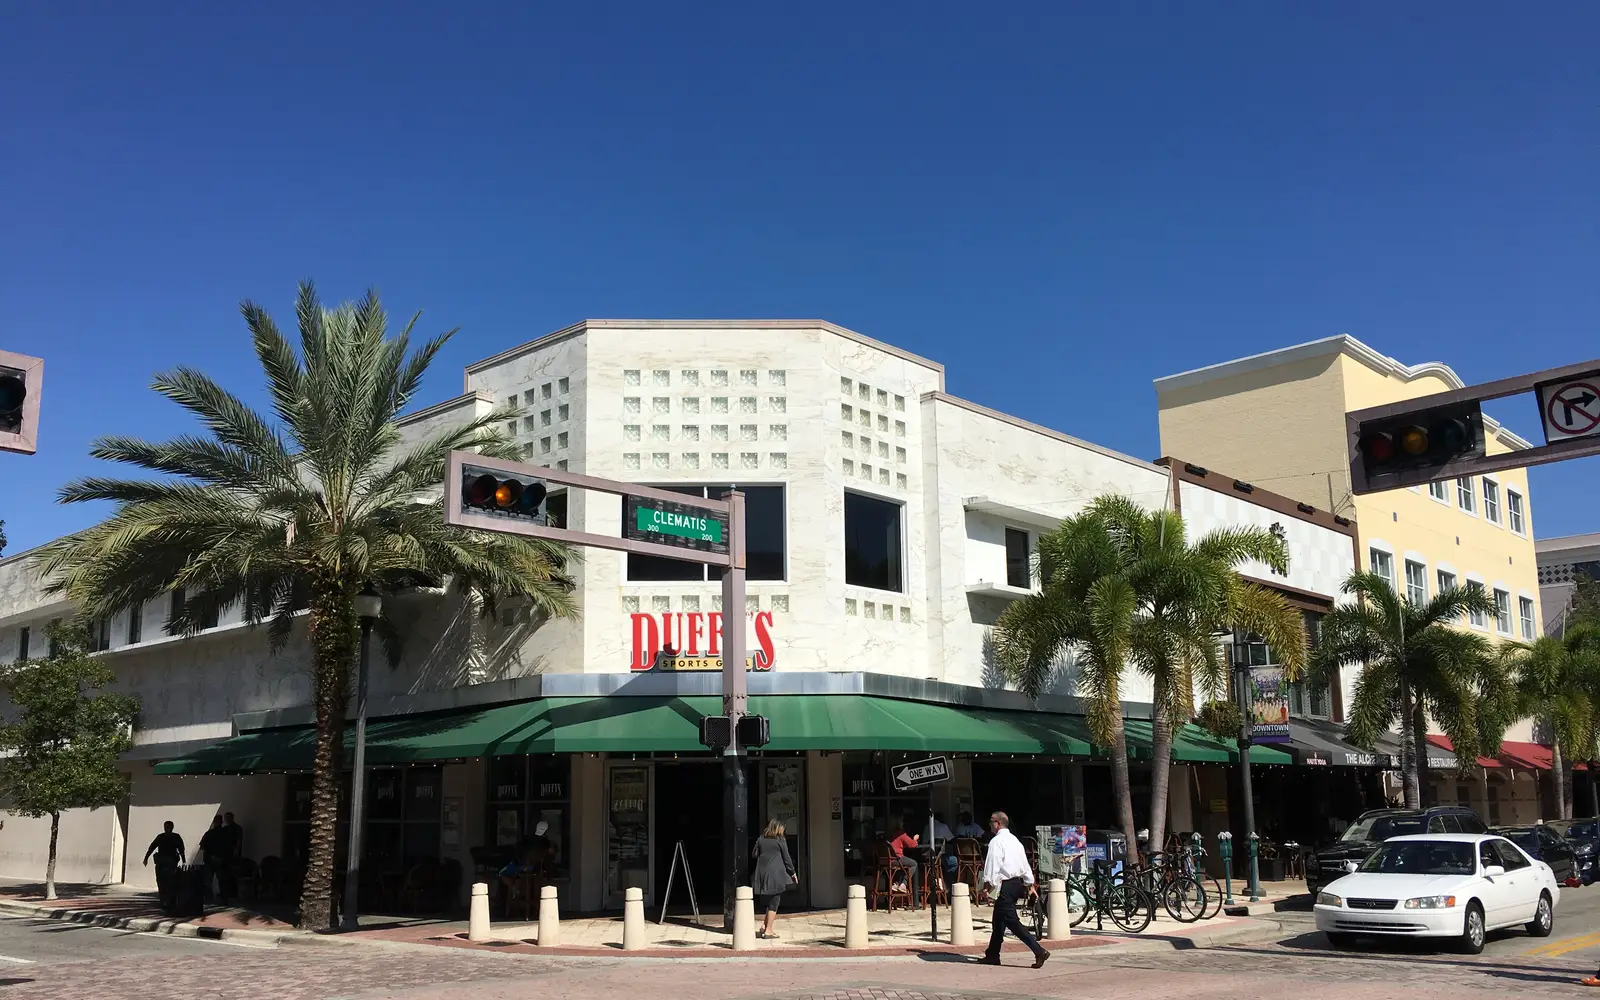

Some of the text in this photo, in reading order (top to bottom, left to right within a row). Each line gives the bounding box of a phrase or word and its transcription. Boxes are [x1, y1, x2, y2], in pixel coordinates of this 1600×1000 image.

[653, 511, 706, 532] CLEMATIS
[647, 524, 659, 532] 300
[701, 533, 713, 542] 200
[630, 611, 774, 671] DUFF'S
[663, 660, 709, 668] SPORTS
[1253, 724, 1289, 732] DOWNTOWN
[1345, 753, 1358, 764] THE
[1431, 758, 1459, 768] RESTAURAN
[909, 764, 943, 779] ONE WAY
